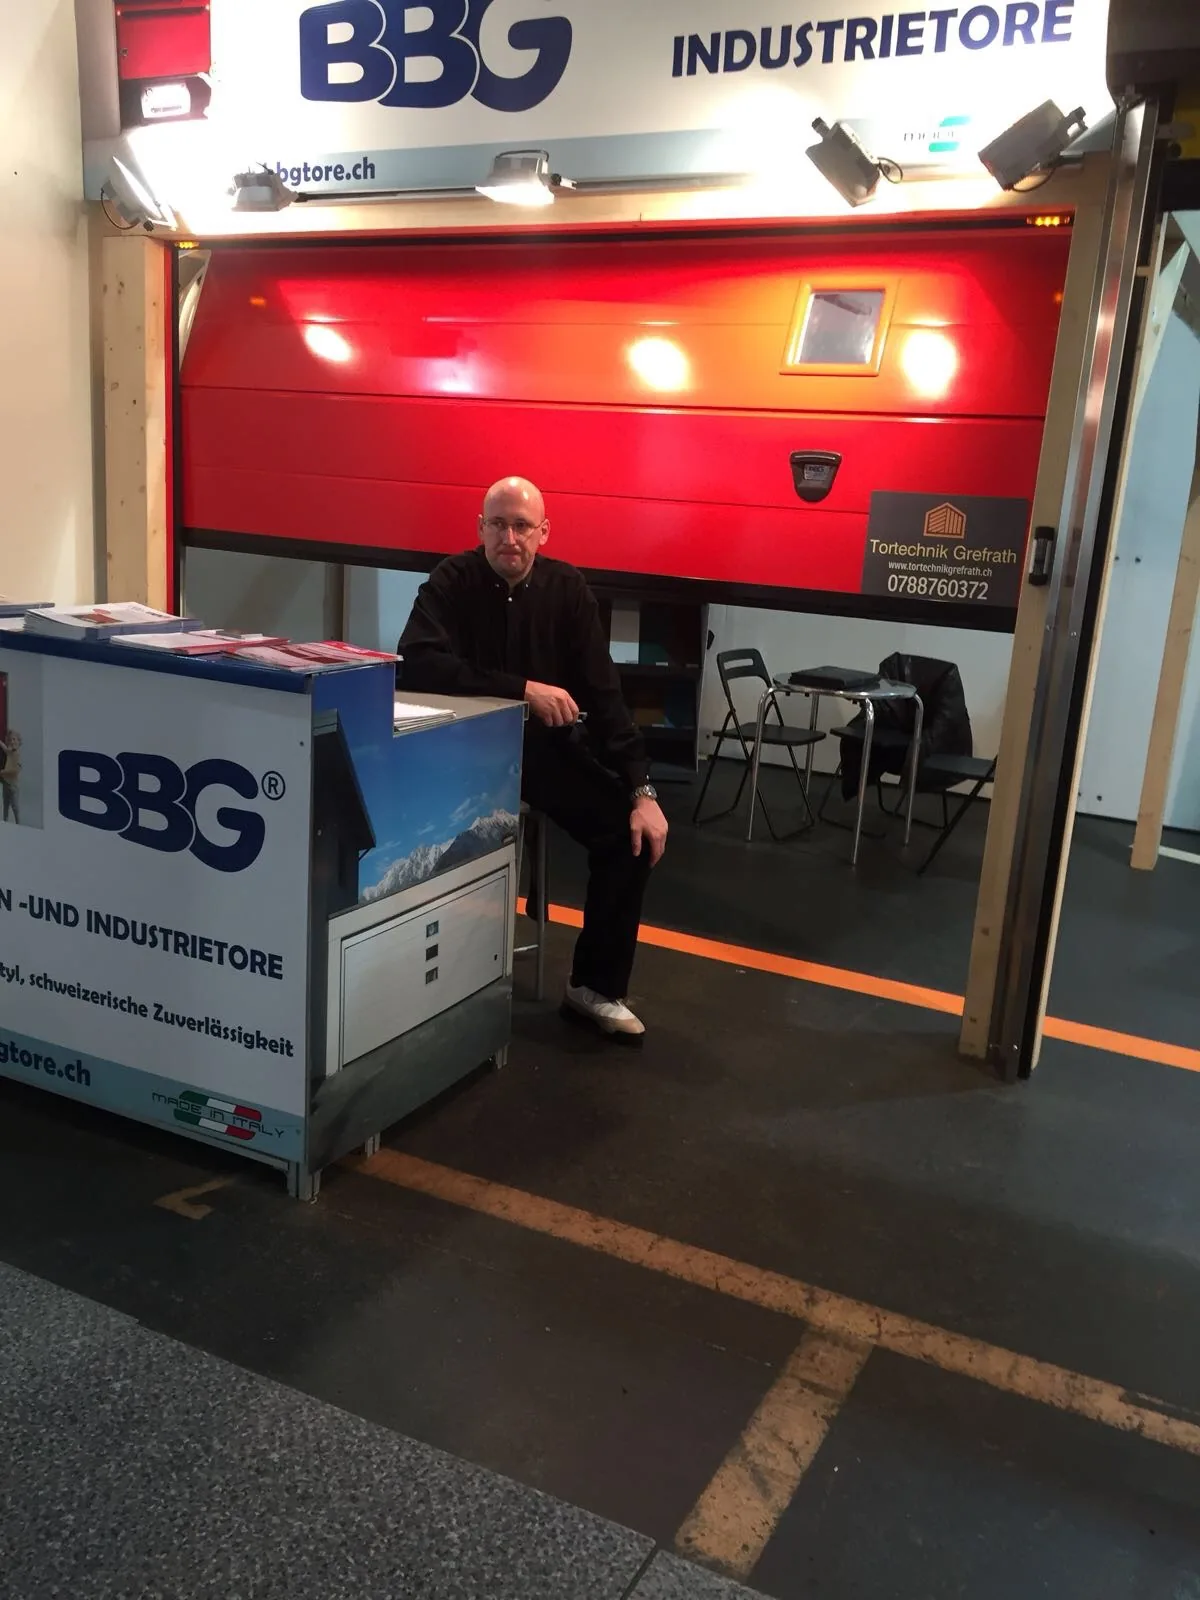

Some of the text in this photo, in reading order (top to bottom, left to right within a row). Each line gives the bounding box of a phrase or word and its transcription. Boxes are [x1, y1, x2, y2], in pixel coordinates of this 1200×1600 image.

[299, 0, 572, 112] BBG
[672, 0, 1073, 77] INDUSTRIETORE
[265, 157, 376, 186] bgtore.ch
[870, 539, 1017, 564] Tortechnik Grefrath
[888, 561, 992, 577] www.tortechnikgrefrath.ch
[887, 574, 989, 600] 0788760372
[58, 749, 266, 873] BBG
[19, 895, 80, 928] -UND
[86, 908, 283, 980] INDUSTRIETORE
[29, 973, 148, 1018] schweizerische
[153, 1002, 294, 1058] Zuverlässigkeit
[152, 1092, 202, 1115] MADE
[233, 1116, 285, 1139] ITALY
